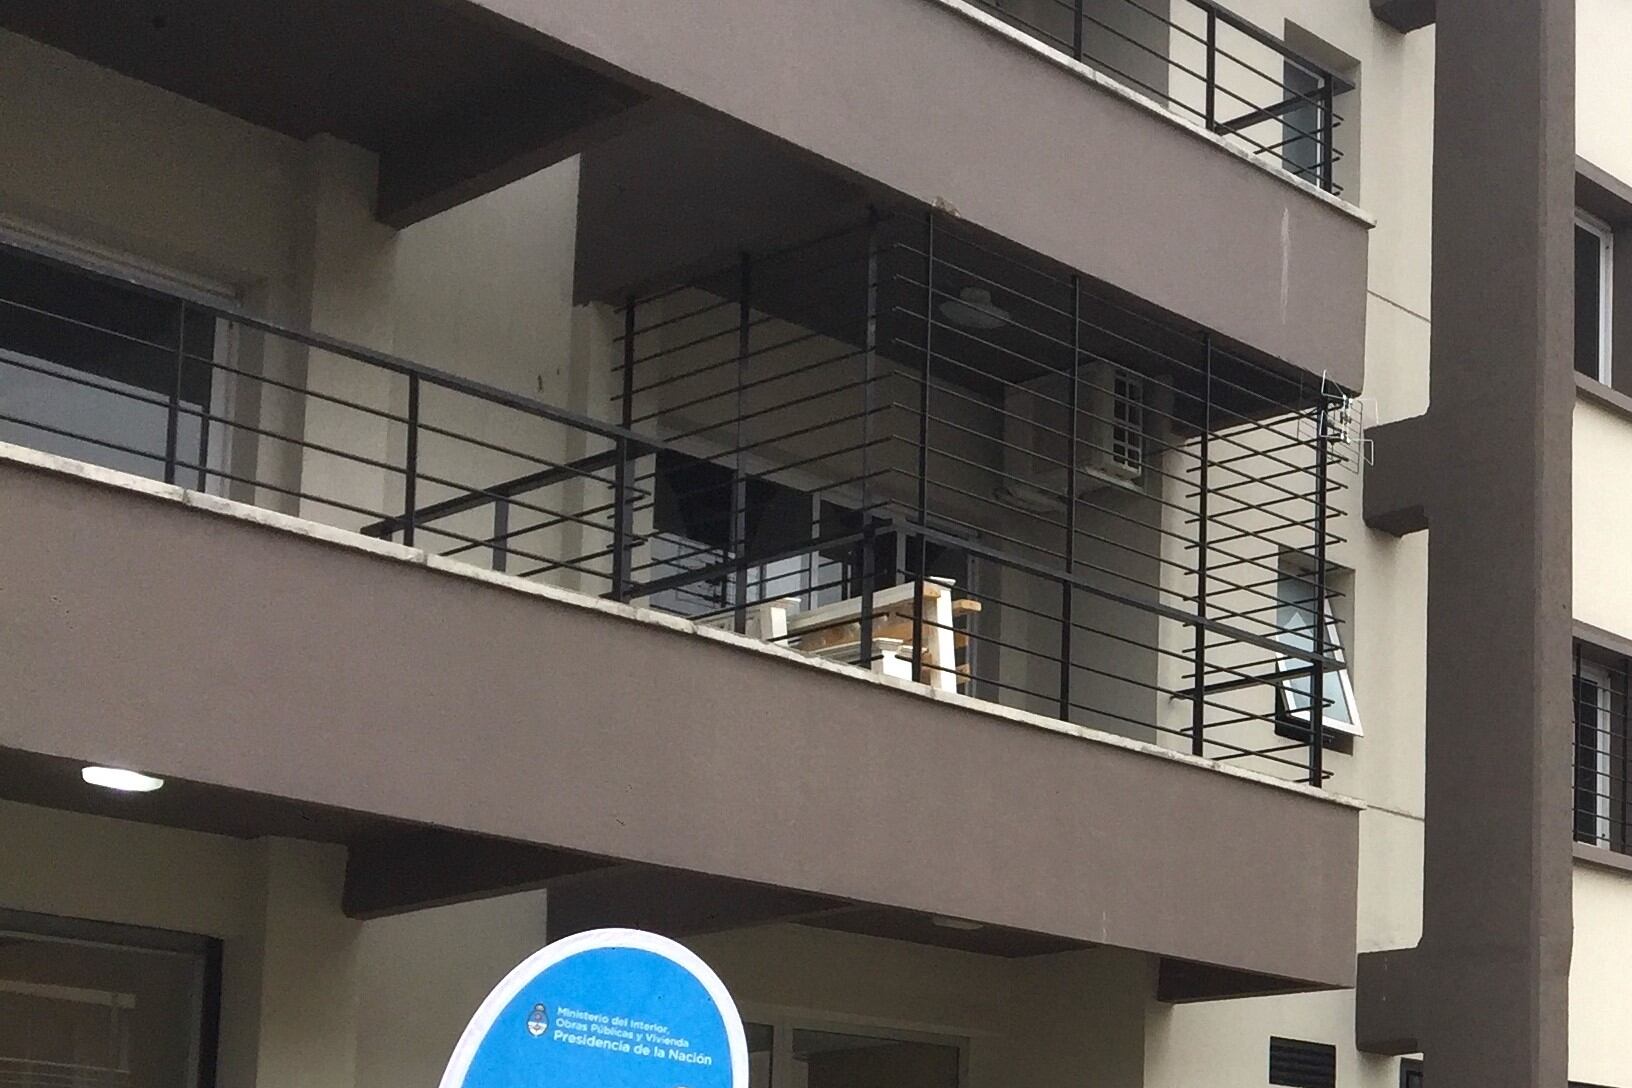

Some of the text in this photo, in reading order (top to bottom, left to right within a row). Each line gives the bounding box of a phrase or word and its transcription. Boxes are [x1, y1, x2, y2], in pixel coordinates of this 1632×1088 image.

[555, 1018, 690, 1048] Obras Públicas y Vivienda
[557, 1006, 671, 1035] Ministerio del Interior,
[553, 1030, 713, 1066] Presidencia de la Nación
